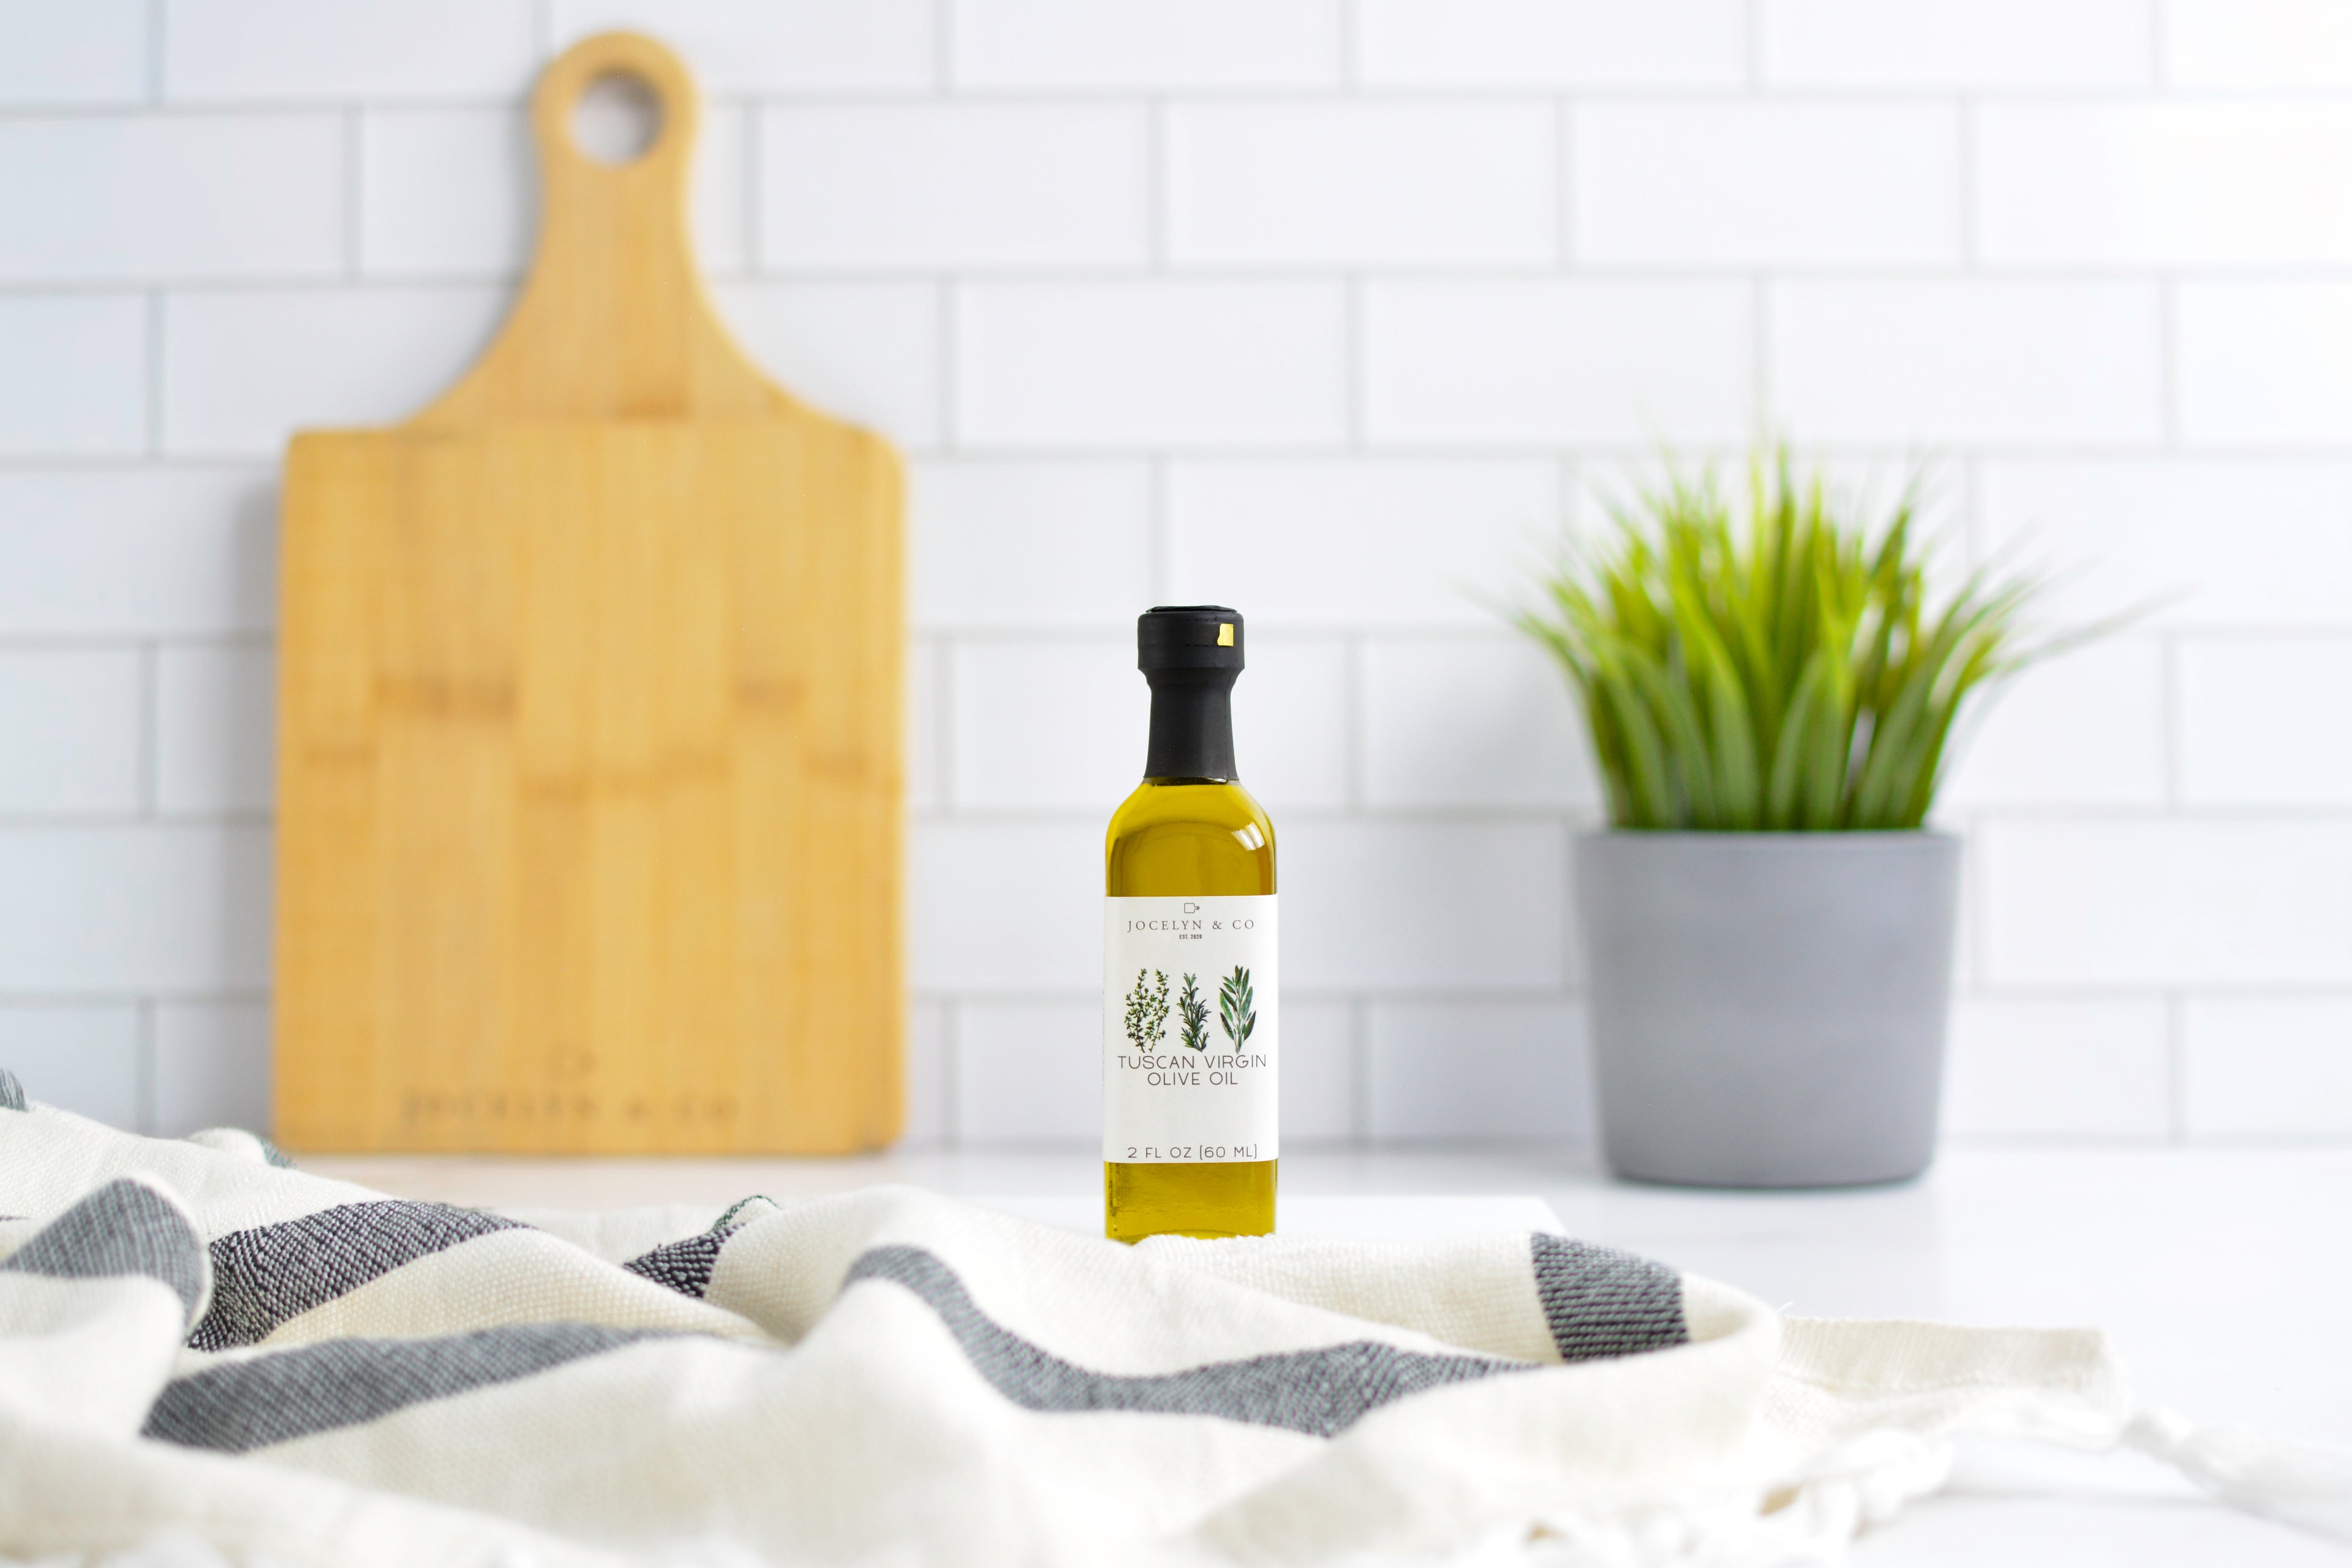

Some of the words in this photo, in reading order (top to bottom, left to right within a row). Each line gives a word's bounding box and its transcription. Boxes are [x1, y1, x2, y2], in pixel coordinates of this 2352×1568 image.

[1127, 921, 1202, 932] JOCELYN
[1212, 921, 1223, 930] &
[1232, 920, 1254, 930] CO
[1118, 1055, 1194, 1069] TUSCAN
[1205, 1054, 1266, 1068] VIRGIN
[1147, 1072, 1200, 1086] OLIVE
[1210, 1072, 1238, 1085] OIL
[1127, 1147, 1137, 1158] 2
[1145, 1147, 1162, 1158] FL
[1170, 1147, 1191, 1158] OZ
